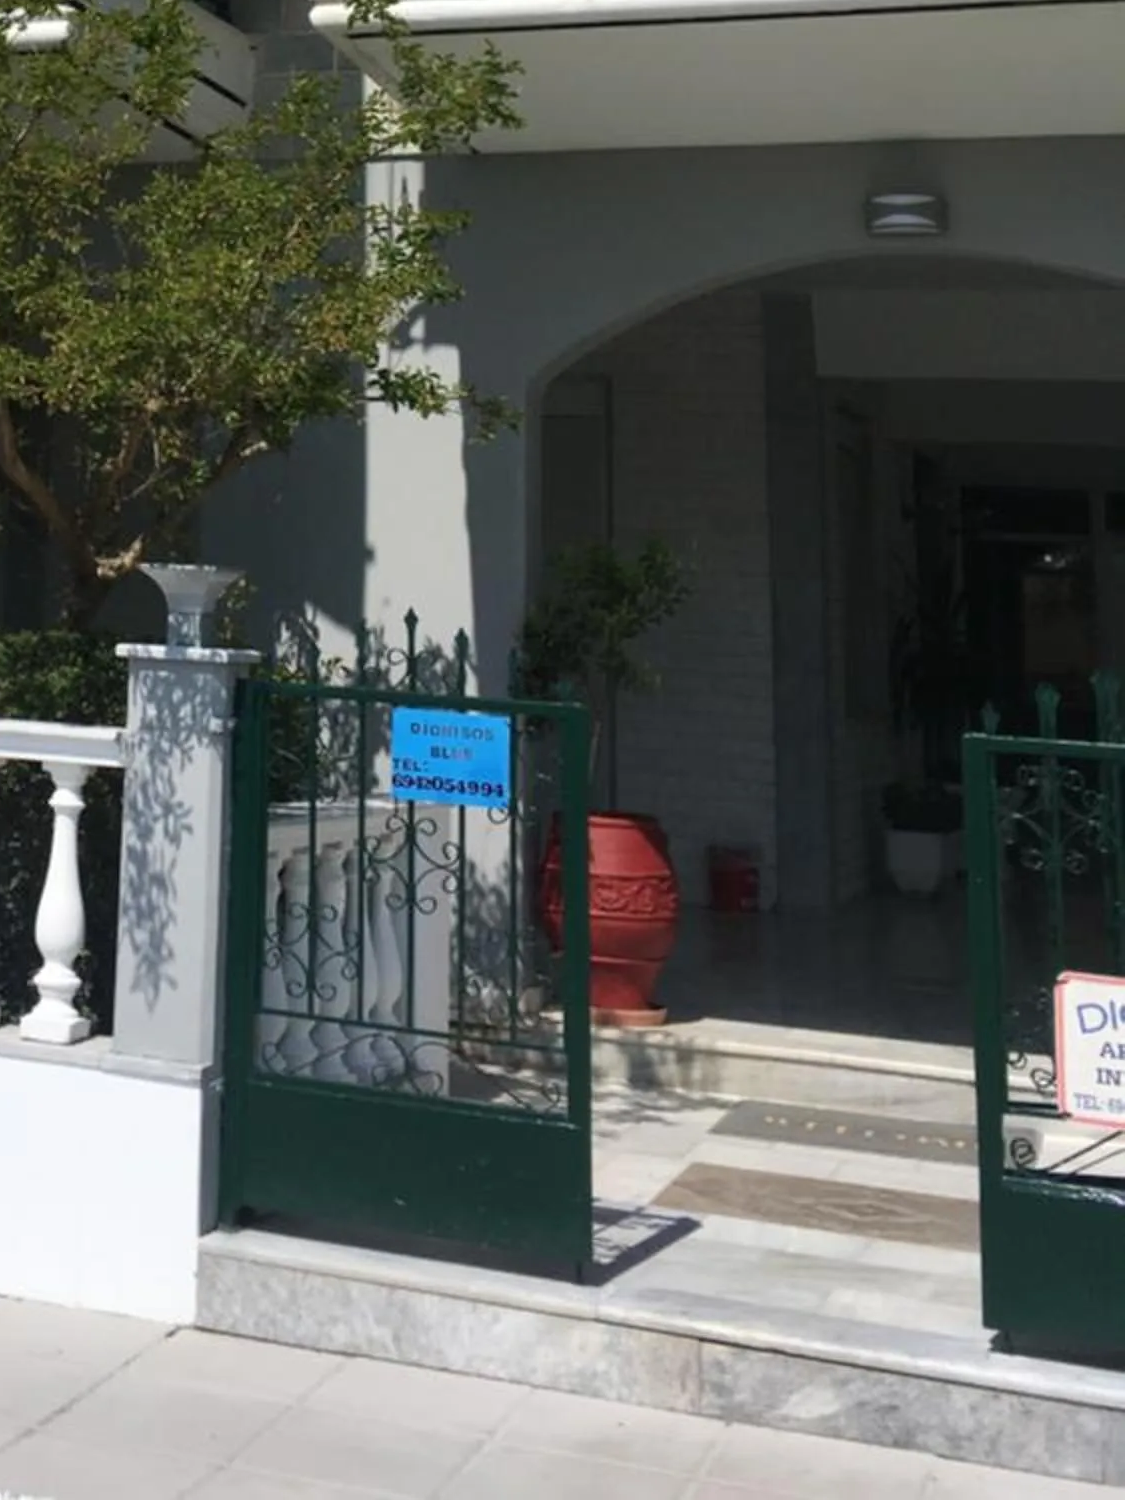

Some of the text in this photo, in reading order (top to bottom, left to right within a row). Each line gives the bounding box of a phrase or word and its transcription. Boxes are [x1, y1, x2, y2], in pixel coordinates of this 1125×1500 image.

[393, 757, 428, 771] TEL:
[1077, 998, 1125, 1034] DI
[1095, 1066, 1125, 1087] IN
